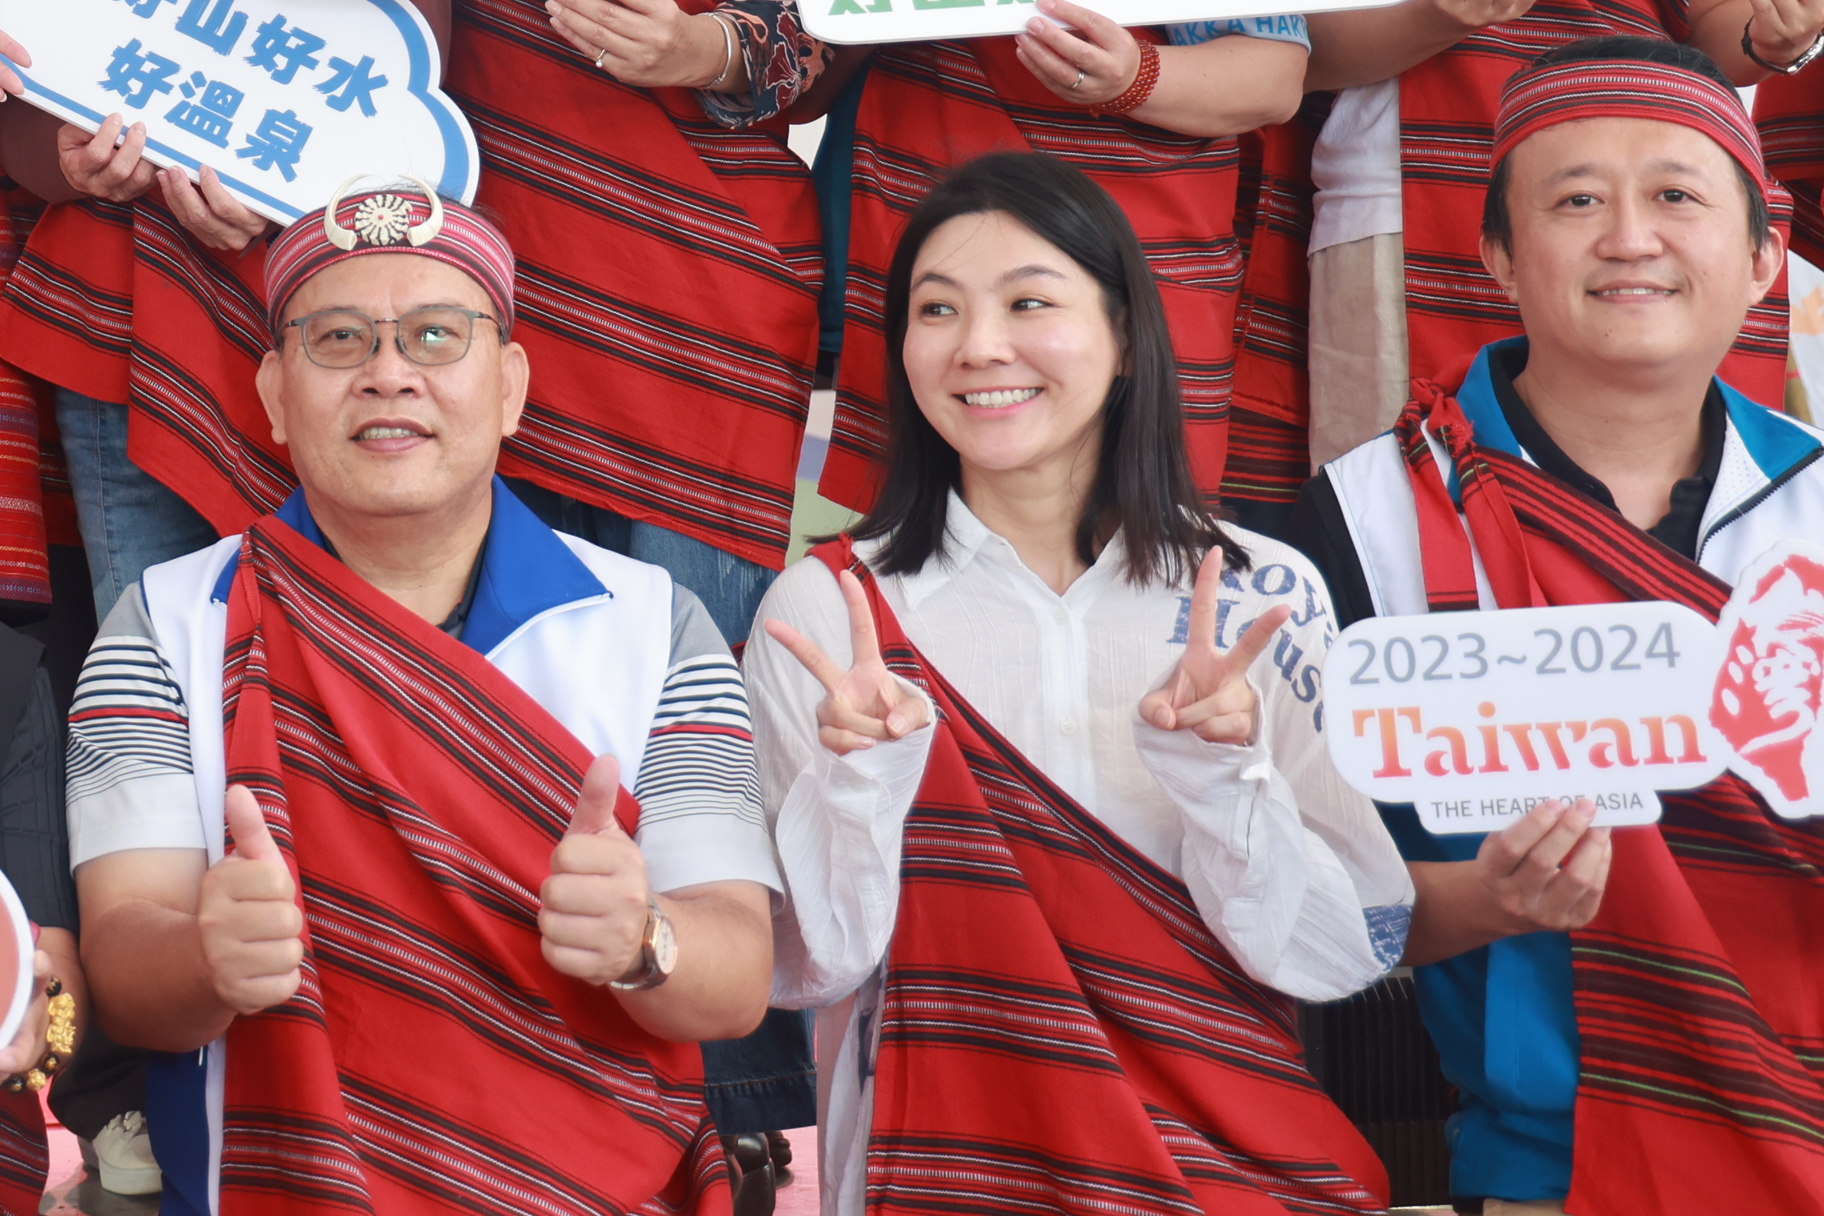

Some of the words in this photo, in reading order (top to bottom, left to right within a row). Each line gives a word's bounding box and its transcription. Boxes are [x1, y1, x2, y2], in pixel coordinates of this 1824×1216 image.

[97, 37, 314, 183] 好溫泉
[1348, 621, 1682, 685] 2023~2024
[1352, 701, 1708, 779] Taiwan
[1430, 800, 1474, 818] THE
[1595, 792, 1644, 811] ASIA
